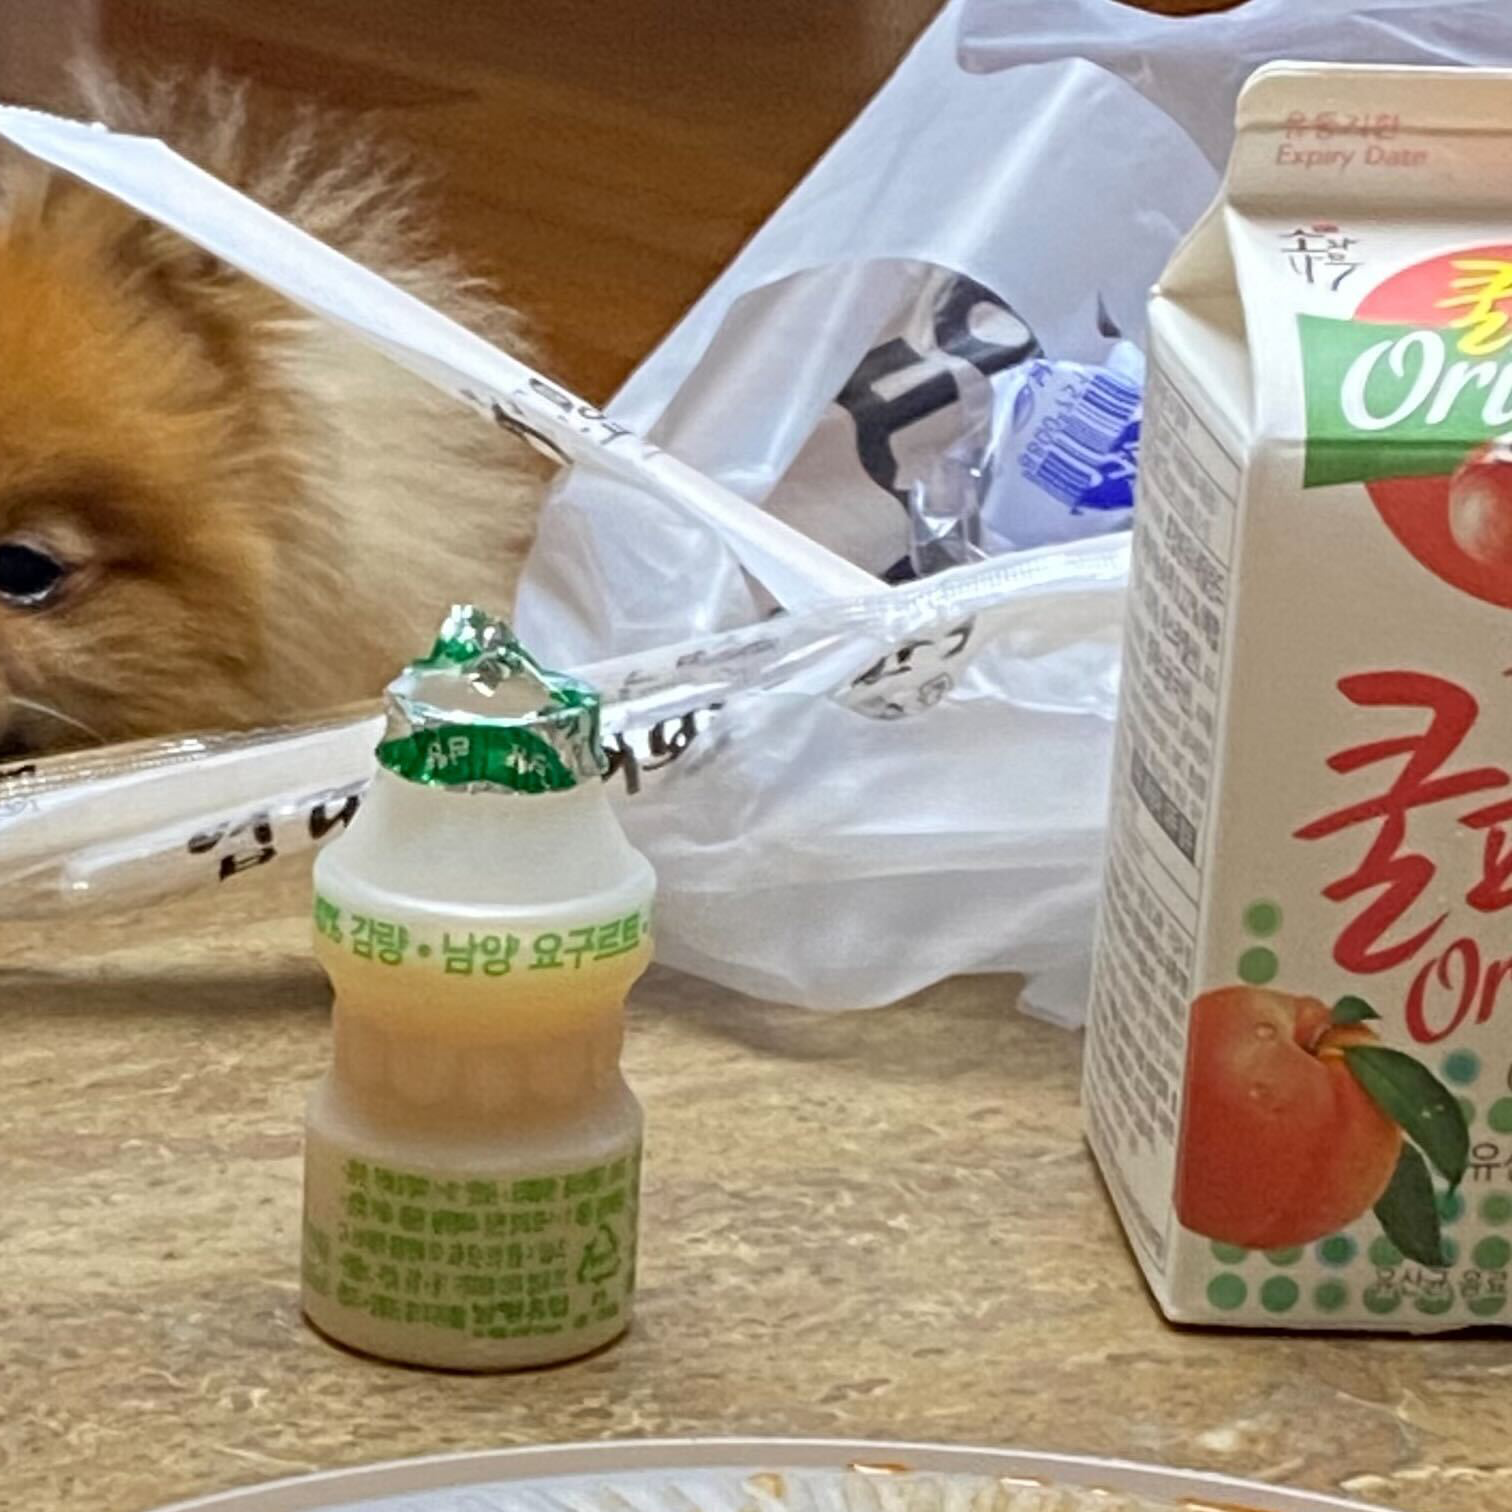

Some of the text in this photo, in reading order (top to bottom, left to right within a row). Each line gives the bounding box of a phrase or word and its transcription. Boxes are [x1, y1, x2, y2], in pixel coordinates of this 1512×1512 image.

[1276, 143, 1429, 174] Expiry Date
[349, 914, 409, 967] 감량
[443, 932, 521, 977] 남양
[528, 908, 641, 969] 요구르트
